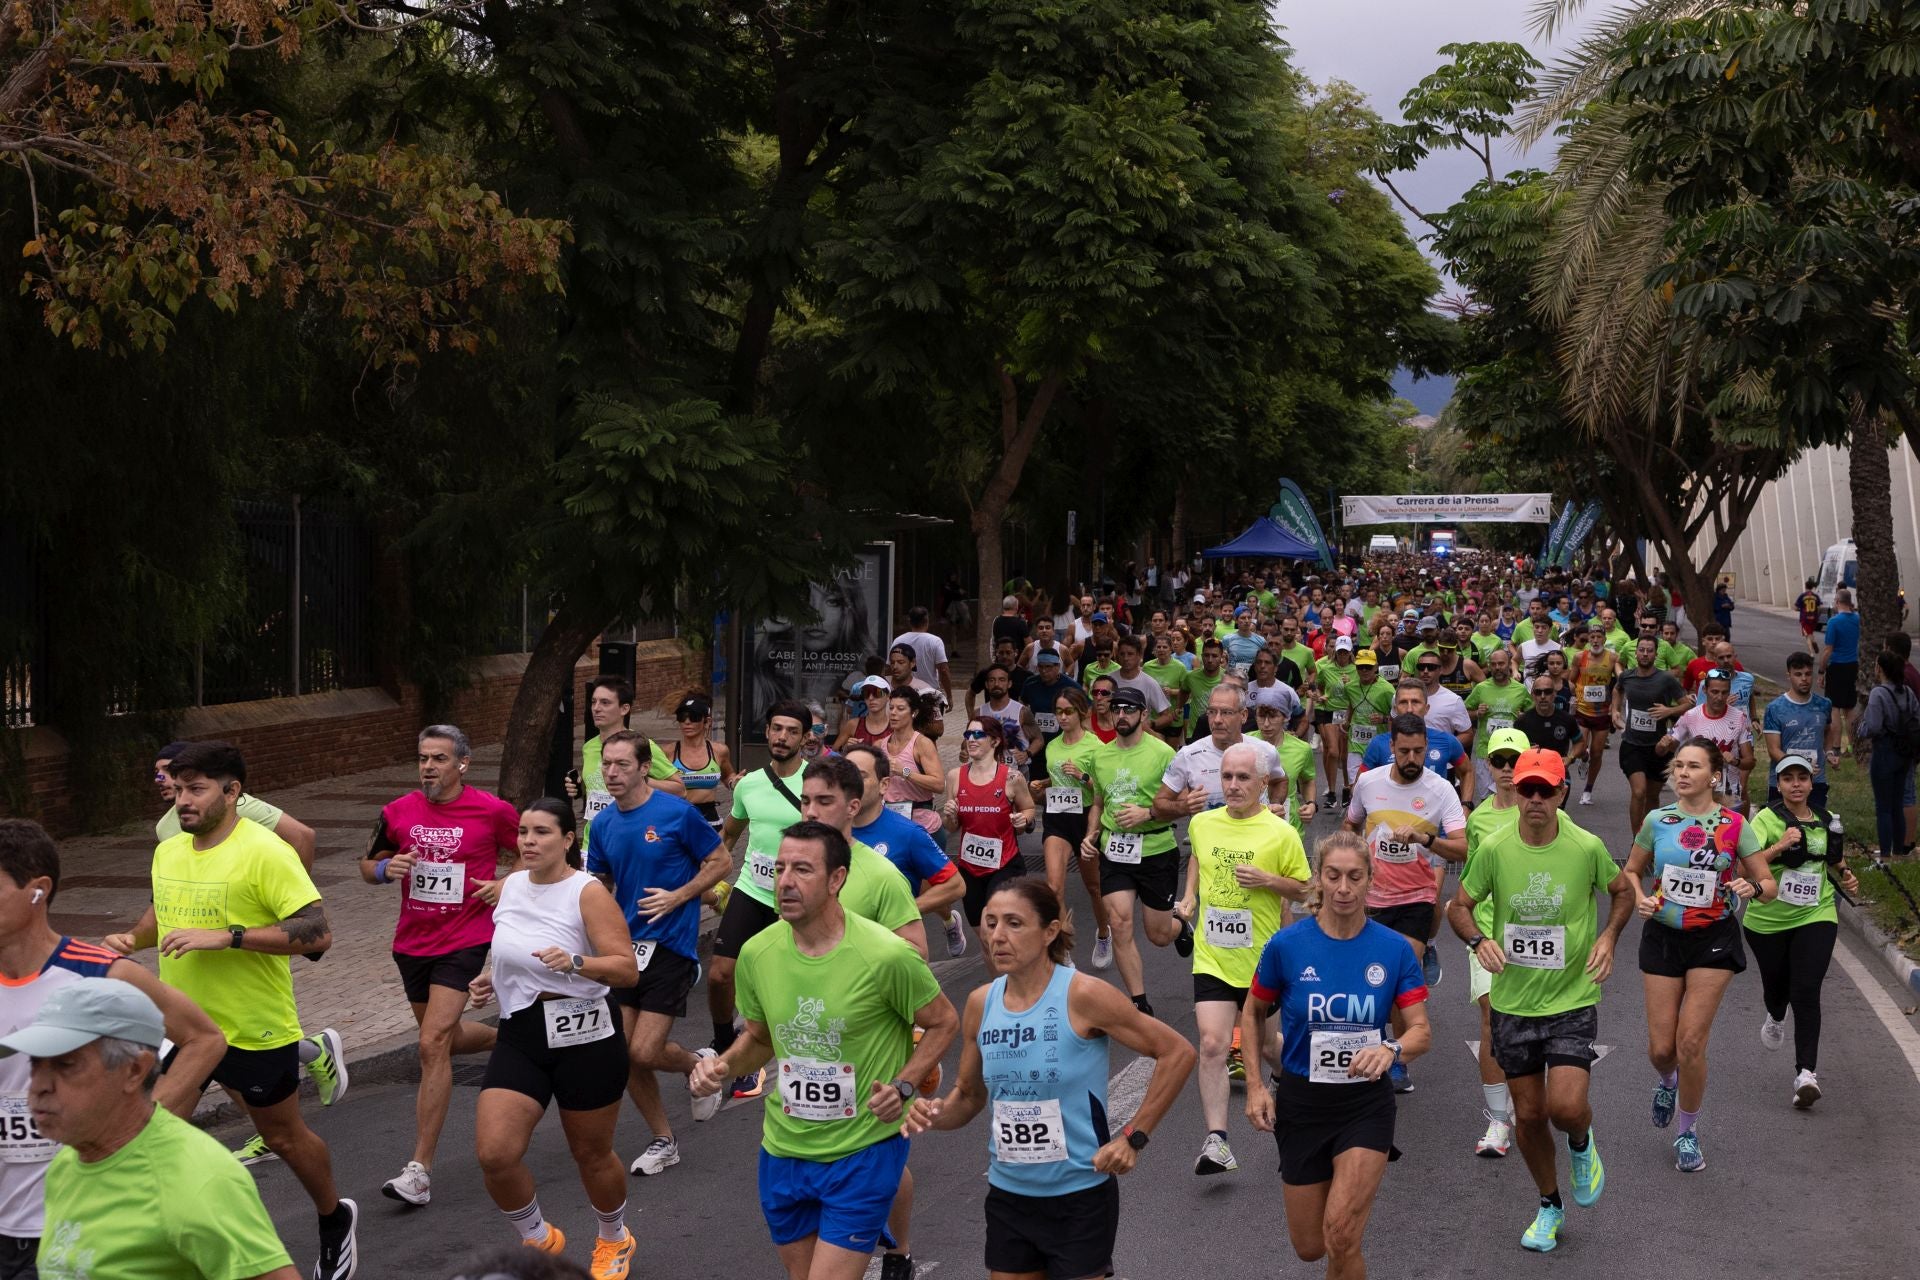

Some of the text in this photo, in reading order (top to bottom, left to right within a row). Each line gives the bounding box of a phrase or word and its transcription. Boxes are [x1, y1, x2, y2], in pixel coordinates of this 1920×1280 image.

[1396, 496, 1500, 506] Carrera de la Prensa
[1803, 599, 1817, 613] 10
[768, 651, 864, 662] CABELO GLOSSY
[805, 662, 855, 671] ANTI-FRIZZ
[1037, 718, 1056, 727] 555
[1354, 730, 1373, 739] 788
[1050, 795, 1079, 804] 1143
[965, 843, 996, 860] 404
[1109, 841, 1135, 855] 557
[1379, 840, 1411, 855] 664
[416, 874, 452, 891] 971
[1669, 878, 1705, 897] 701
[1785, 881, 1818, 896] 1696
[1208, 920, 1247, 935] 1140
[1512, 939, 1555, 956] 618
[1308, 993, 1376, 1024] RCM
[555, 1009, 600, 1034] 277
[982, 1022, 1037, 1049] nerja
[788, 1080, 841, 1103] 169
[1000, 1123, 1051, 1145] 582
